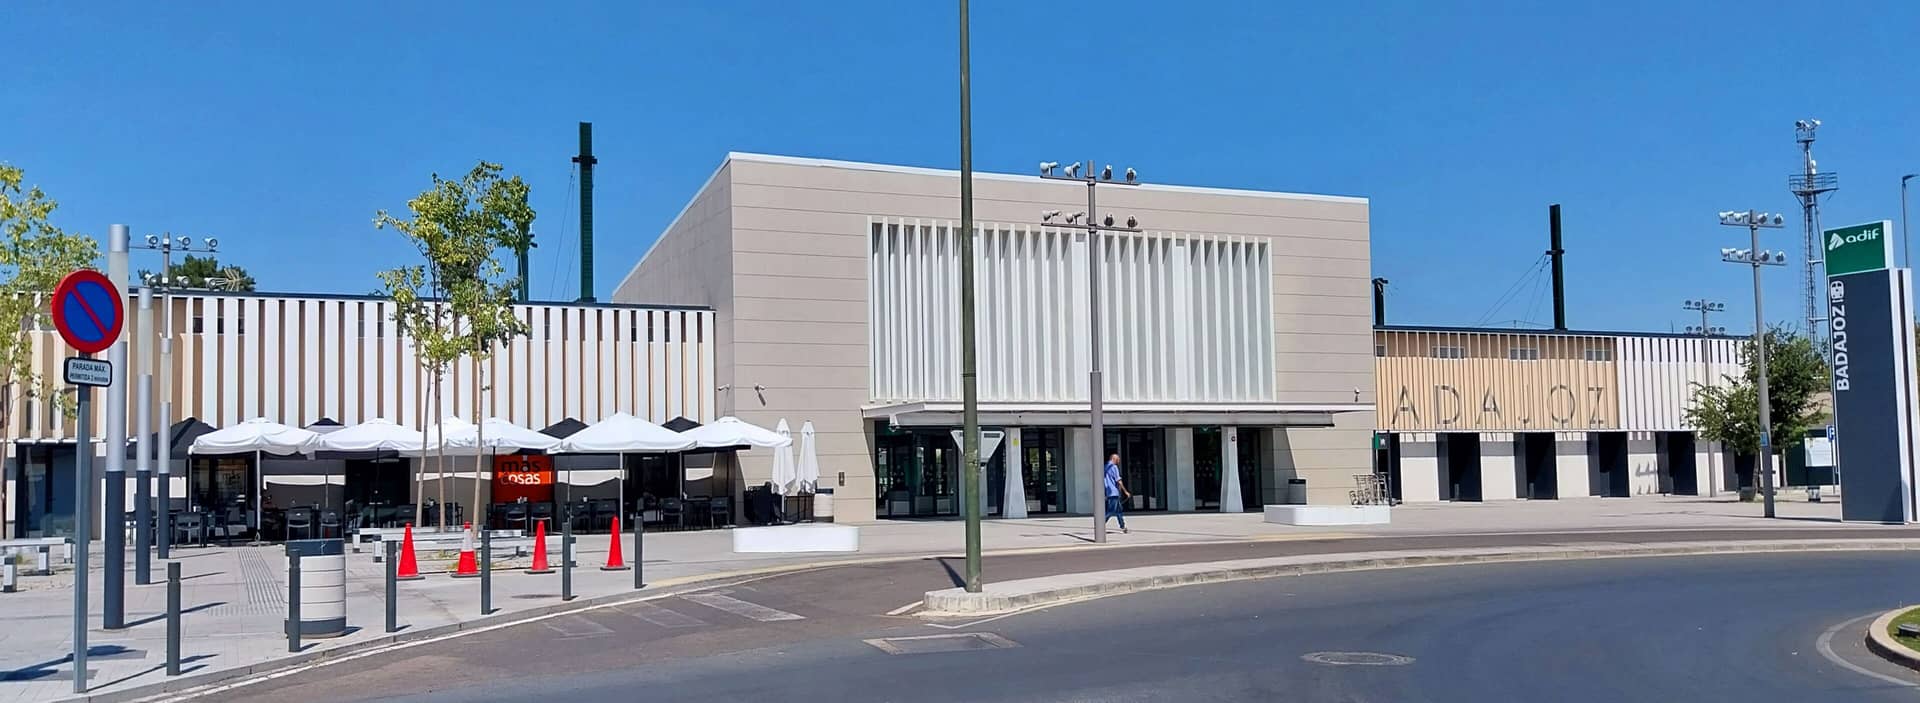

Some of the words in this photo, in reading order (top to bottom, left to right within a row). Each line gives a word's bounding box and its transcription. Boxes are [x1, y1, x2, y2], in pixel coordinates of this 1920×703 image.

[1846, 228, 1880, 243] adif
[1832, 304, 1850, 391] BADAJOZ
[72, 362, 93, 371] PARADA
[1391, 384, 1604, 425] ADAJOZ
